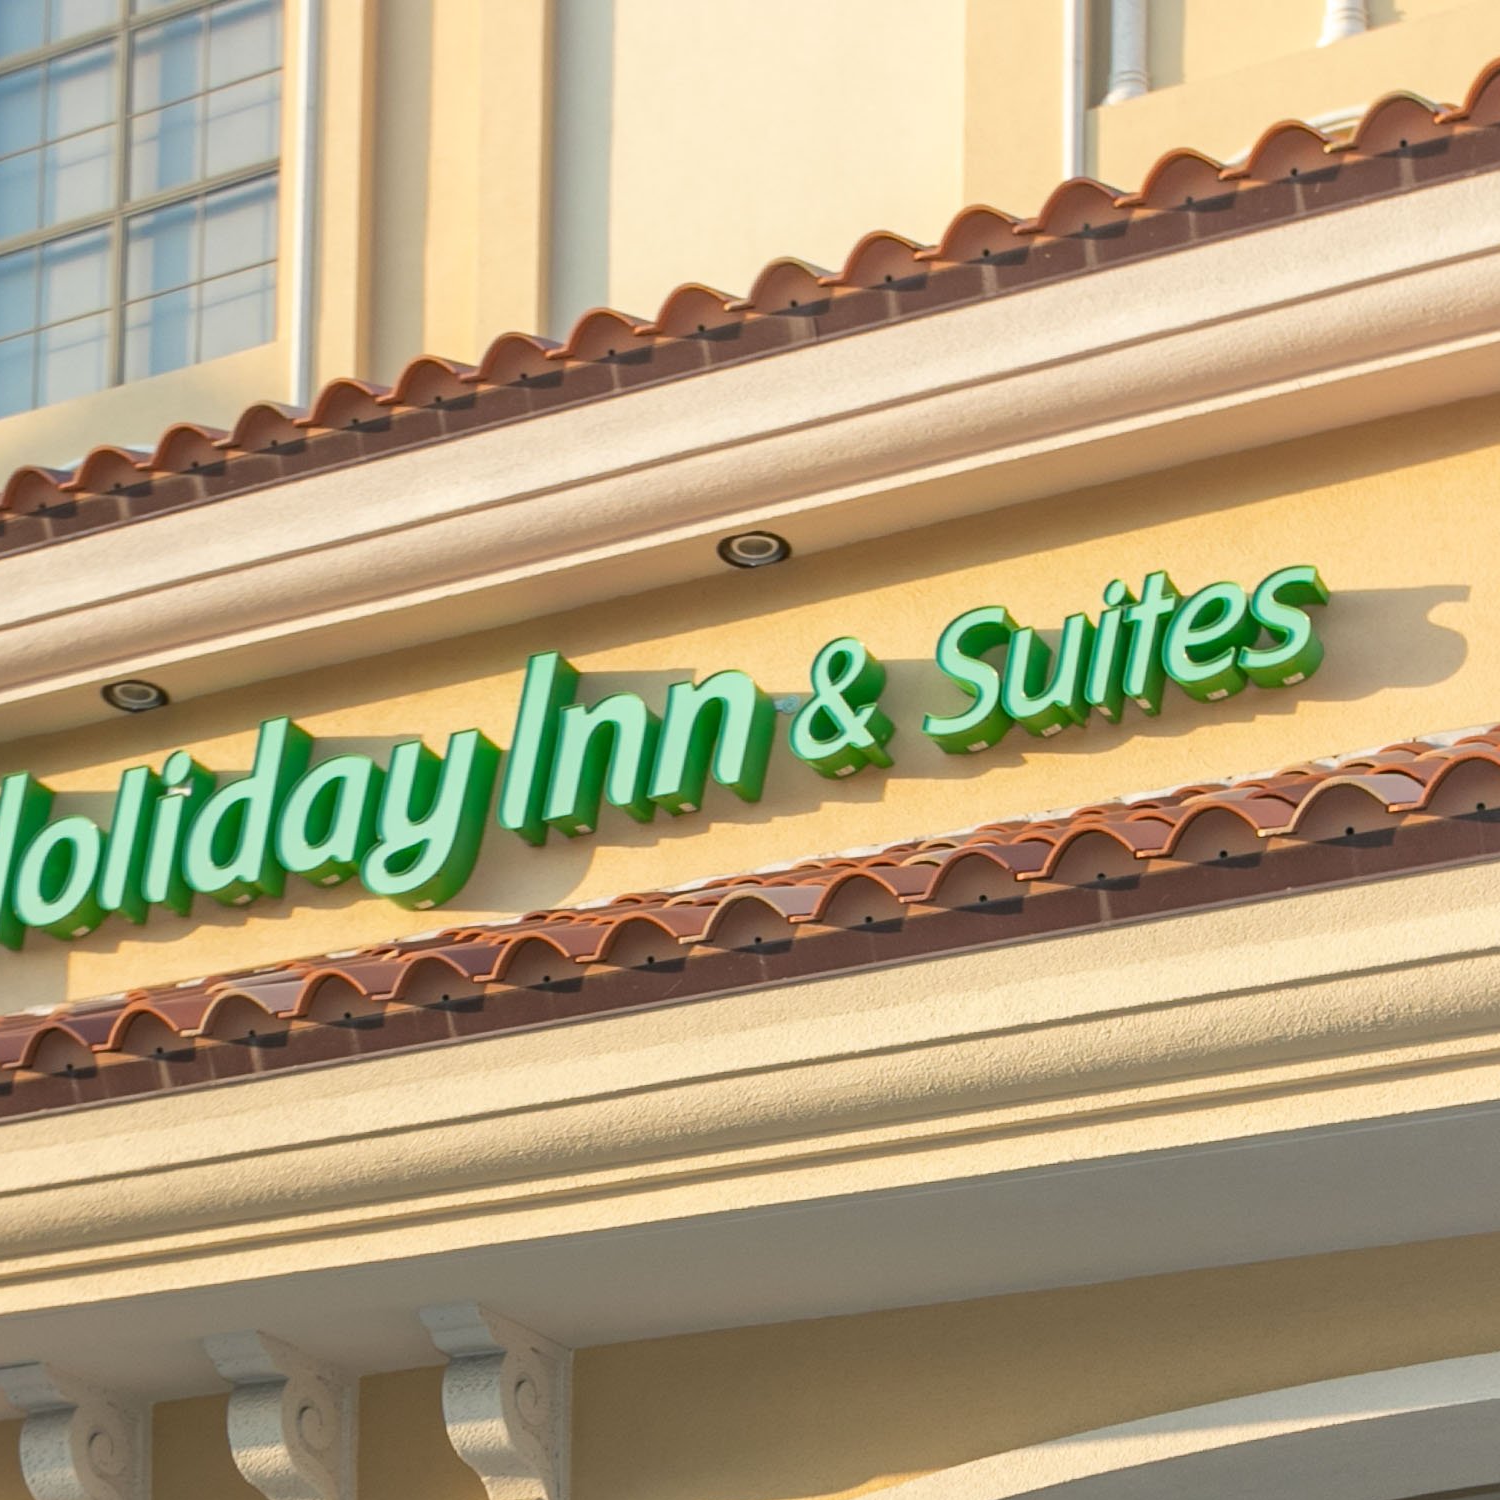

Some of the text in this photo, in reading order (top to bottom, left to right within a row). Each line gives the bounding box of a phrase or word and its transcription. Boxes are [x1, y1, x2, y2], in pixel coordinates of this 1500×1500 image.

[498, 650, 775, 846] Inn
[788, 636, 895, 780] &
[922, 565, 1331, 755] Suites
